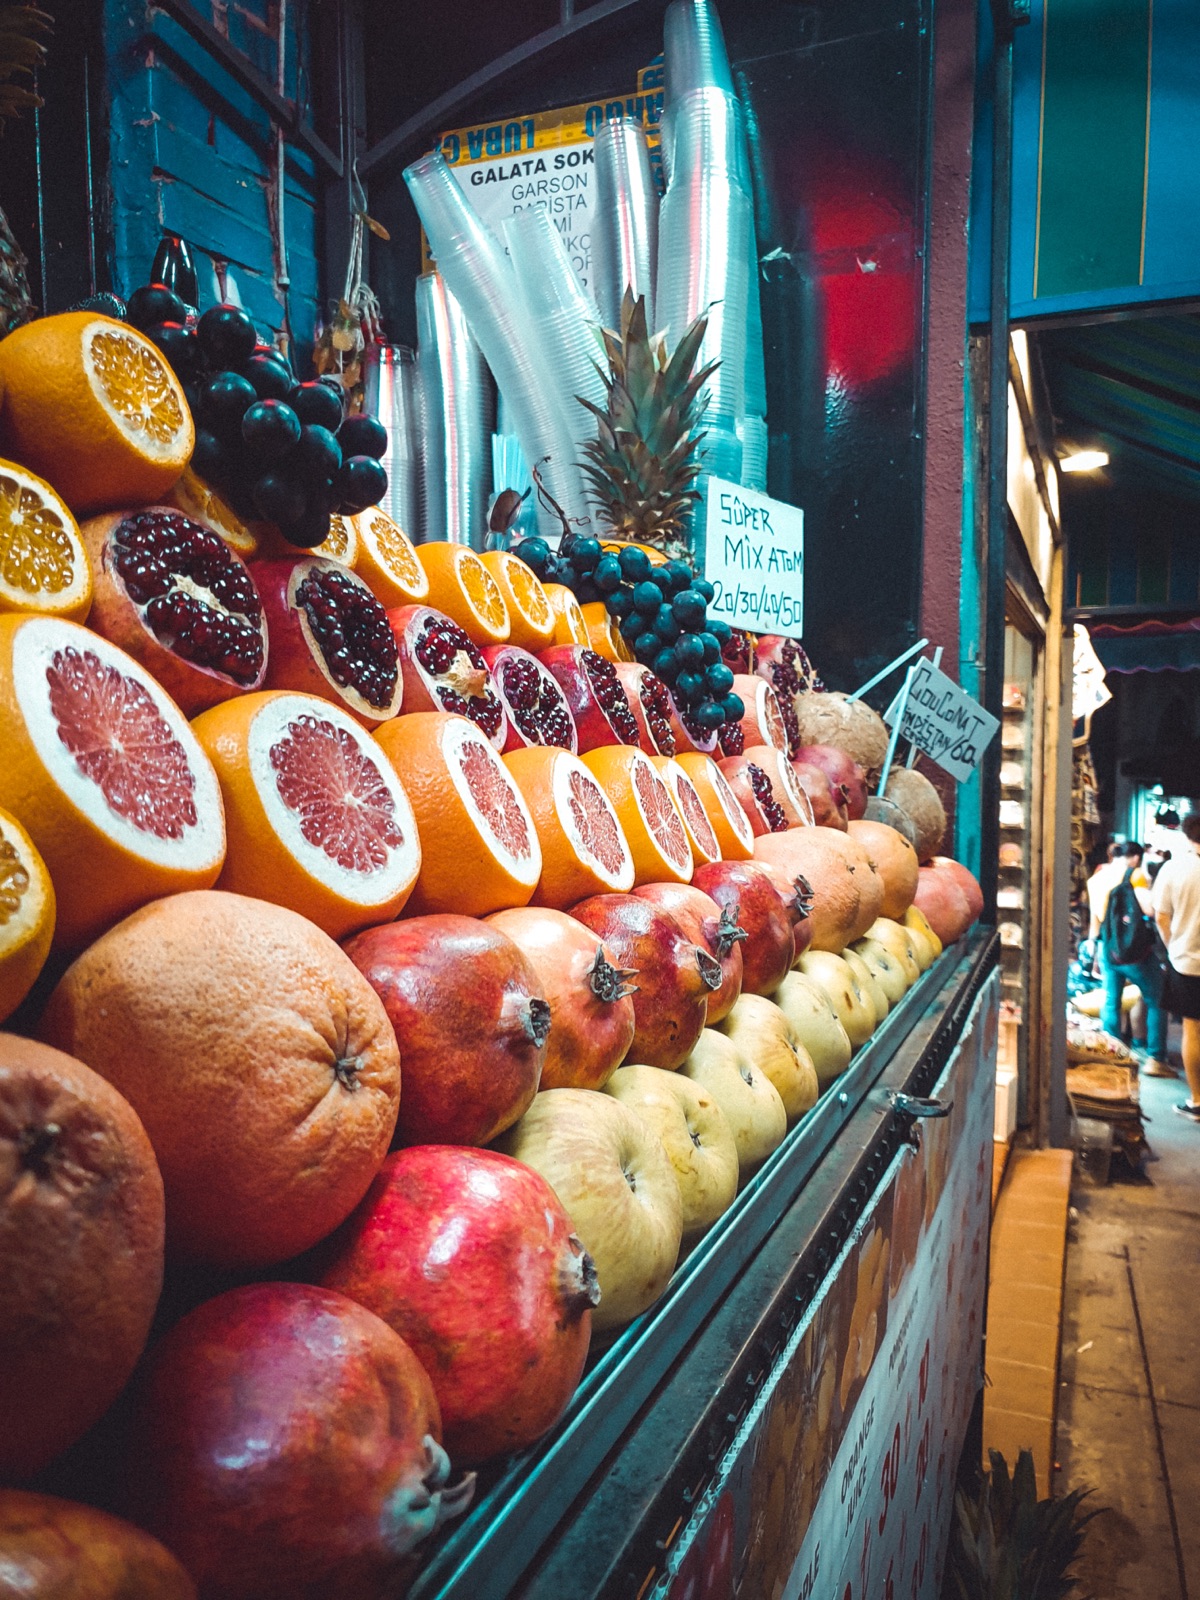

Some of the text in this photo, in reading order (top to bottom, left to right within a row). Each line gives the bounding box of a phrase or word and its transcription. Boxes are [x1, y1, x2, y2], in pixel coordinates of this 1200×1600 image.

[434, 134, 460, 164] C
[467, 119, 535, 160] LUBA
[471, 158, 547, 186] GALATA
[511, 172, 588, 201] GARSON
[841, 1396, 876, 1504] ORANGE
[844, 1454, 869, 1538] JUICE
[798, 1541, 821, 1600] PLE
